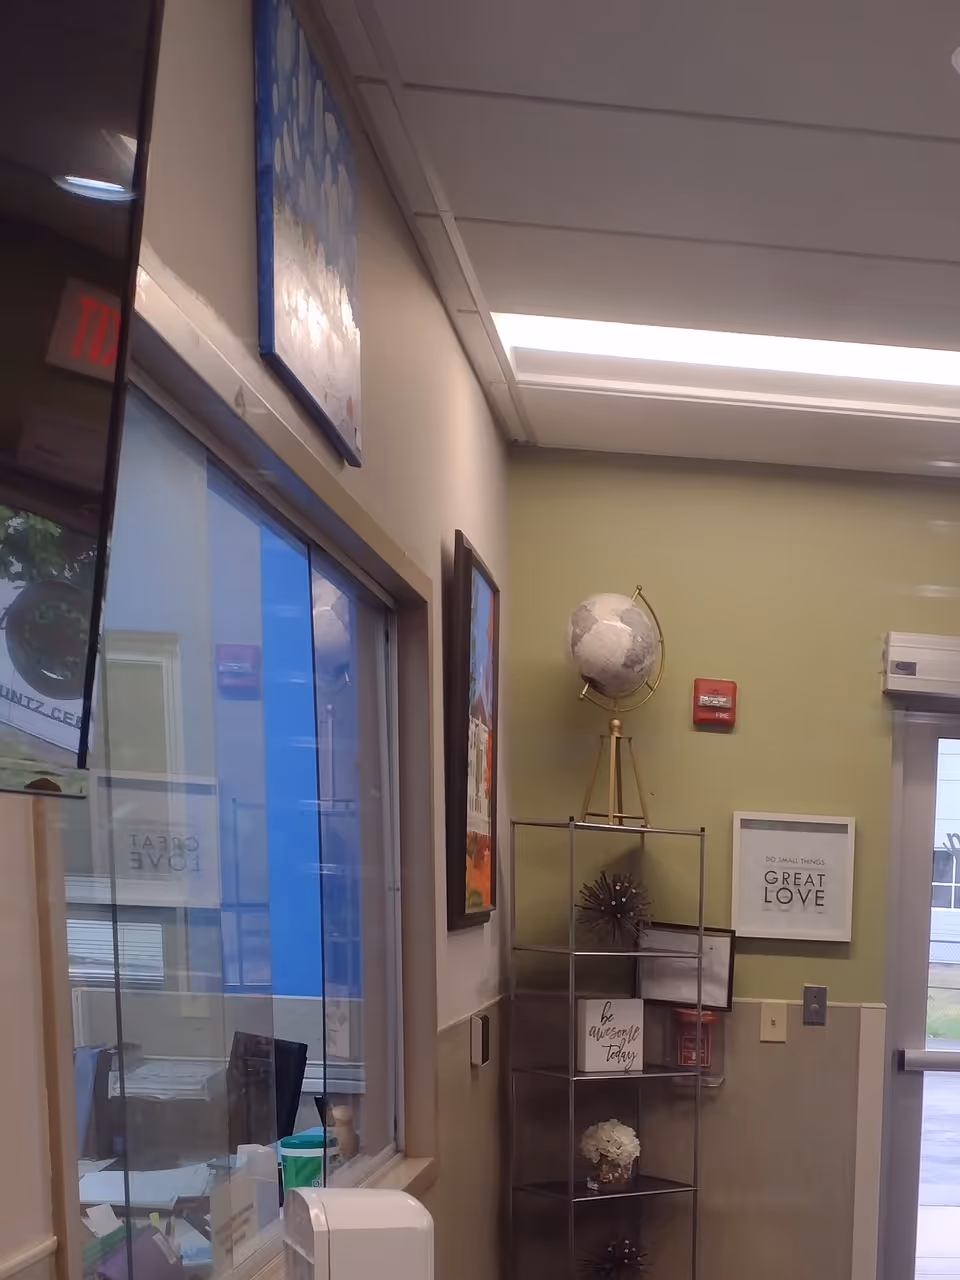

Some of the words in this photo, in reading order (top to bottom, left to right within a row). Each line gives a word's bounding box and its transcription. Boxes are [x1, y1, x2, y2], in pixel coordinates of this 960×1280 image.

[778, 857, 799, 865] SMALL
[800, 858, 826, 866] THINGS
[764, 870, 826, 888] GREAT
[764, 886, 825, 907] LOVE
[600, 1000, 614, 1025] be
[588, 1024, 640, 1044] awesome
